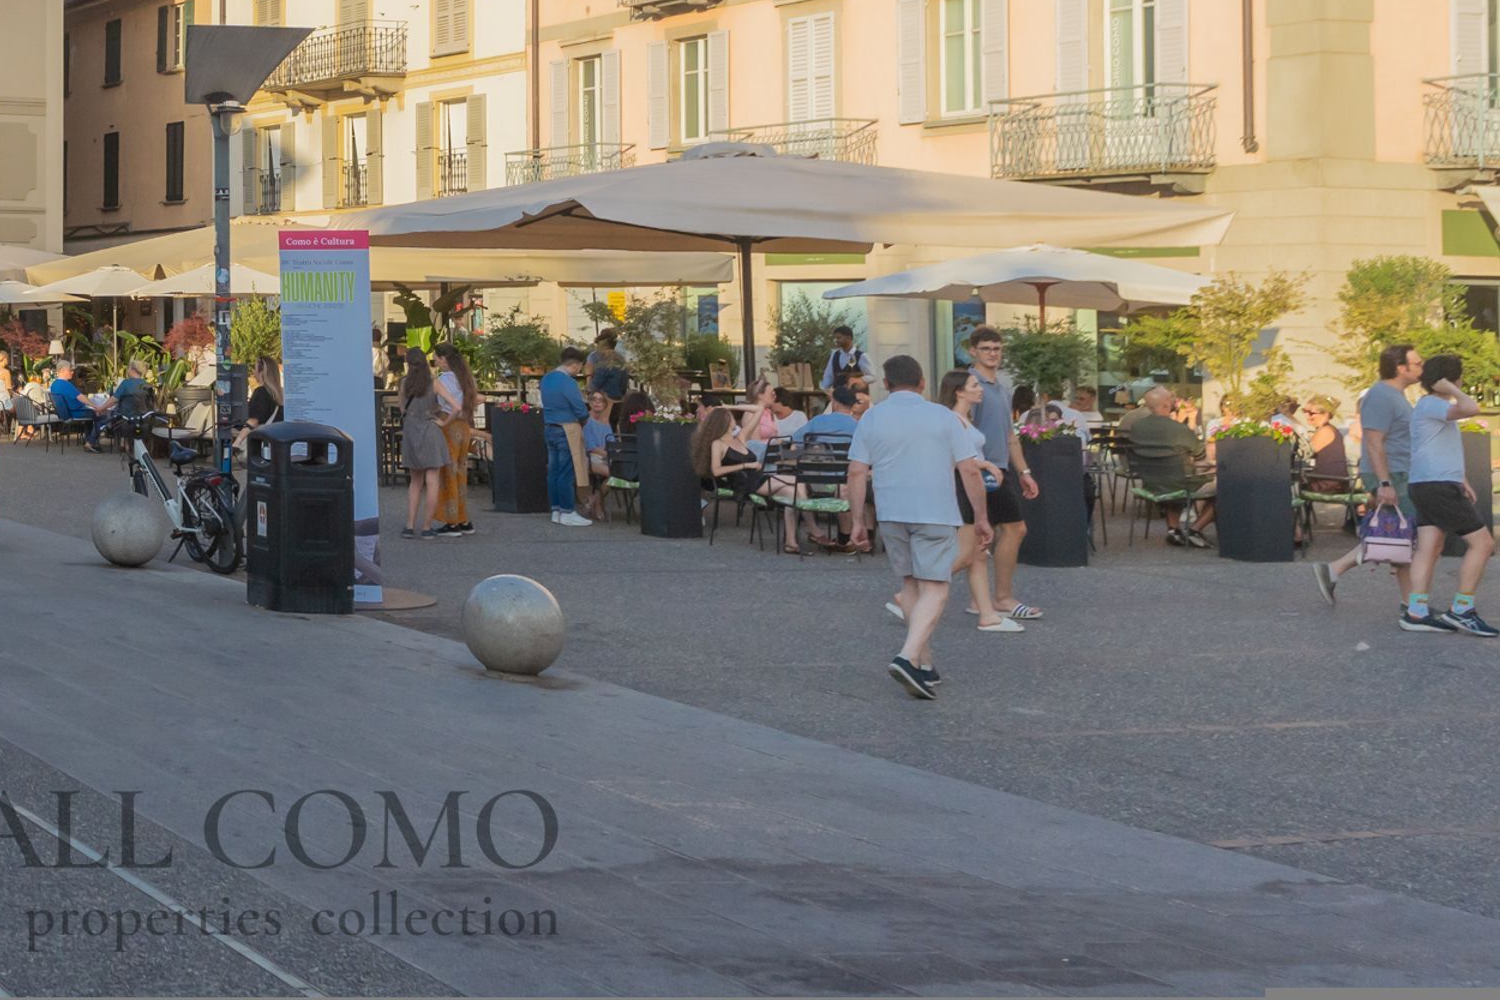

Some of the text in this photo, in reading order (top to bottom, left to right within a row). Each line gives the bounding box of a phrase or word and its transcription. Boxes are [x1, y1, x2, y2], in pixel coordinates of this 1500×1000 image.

[285, 237, 311, 246] Como
[320, 236, 355, 246] Cultura
[281, 270, 356, 303] HUMANITY
